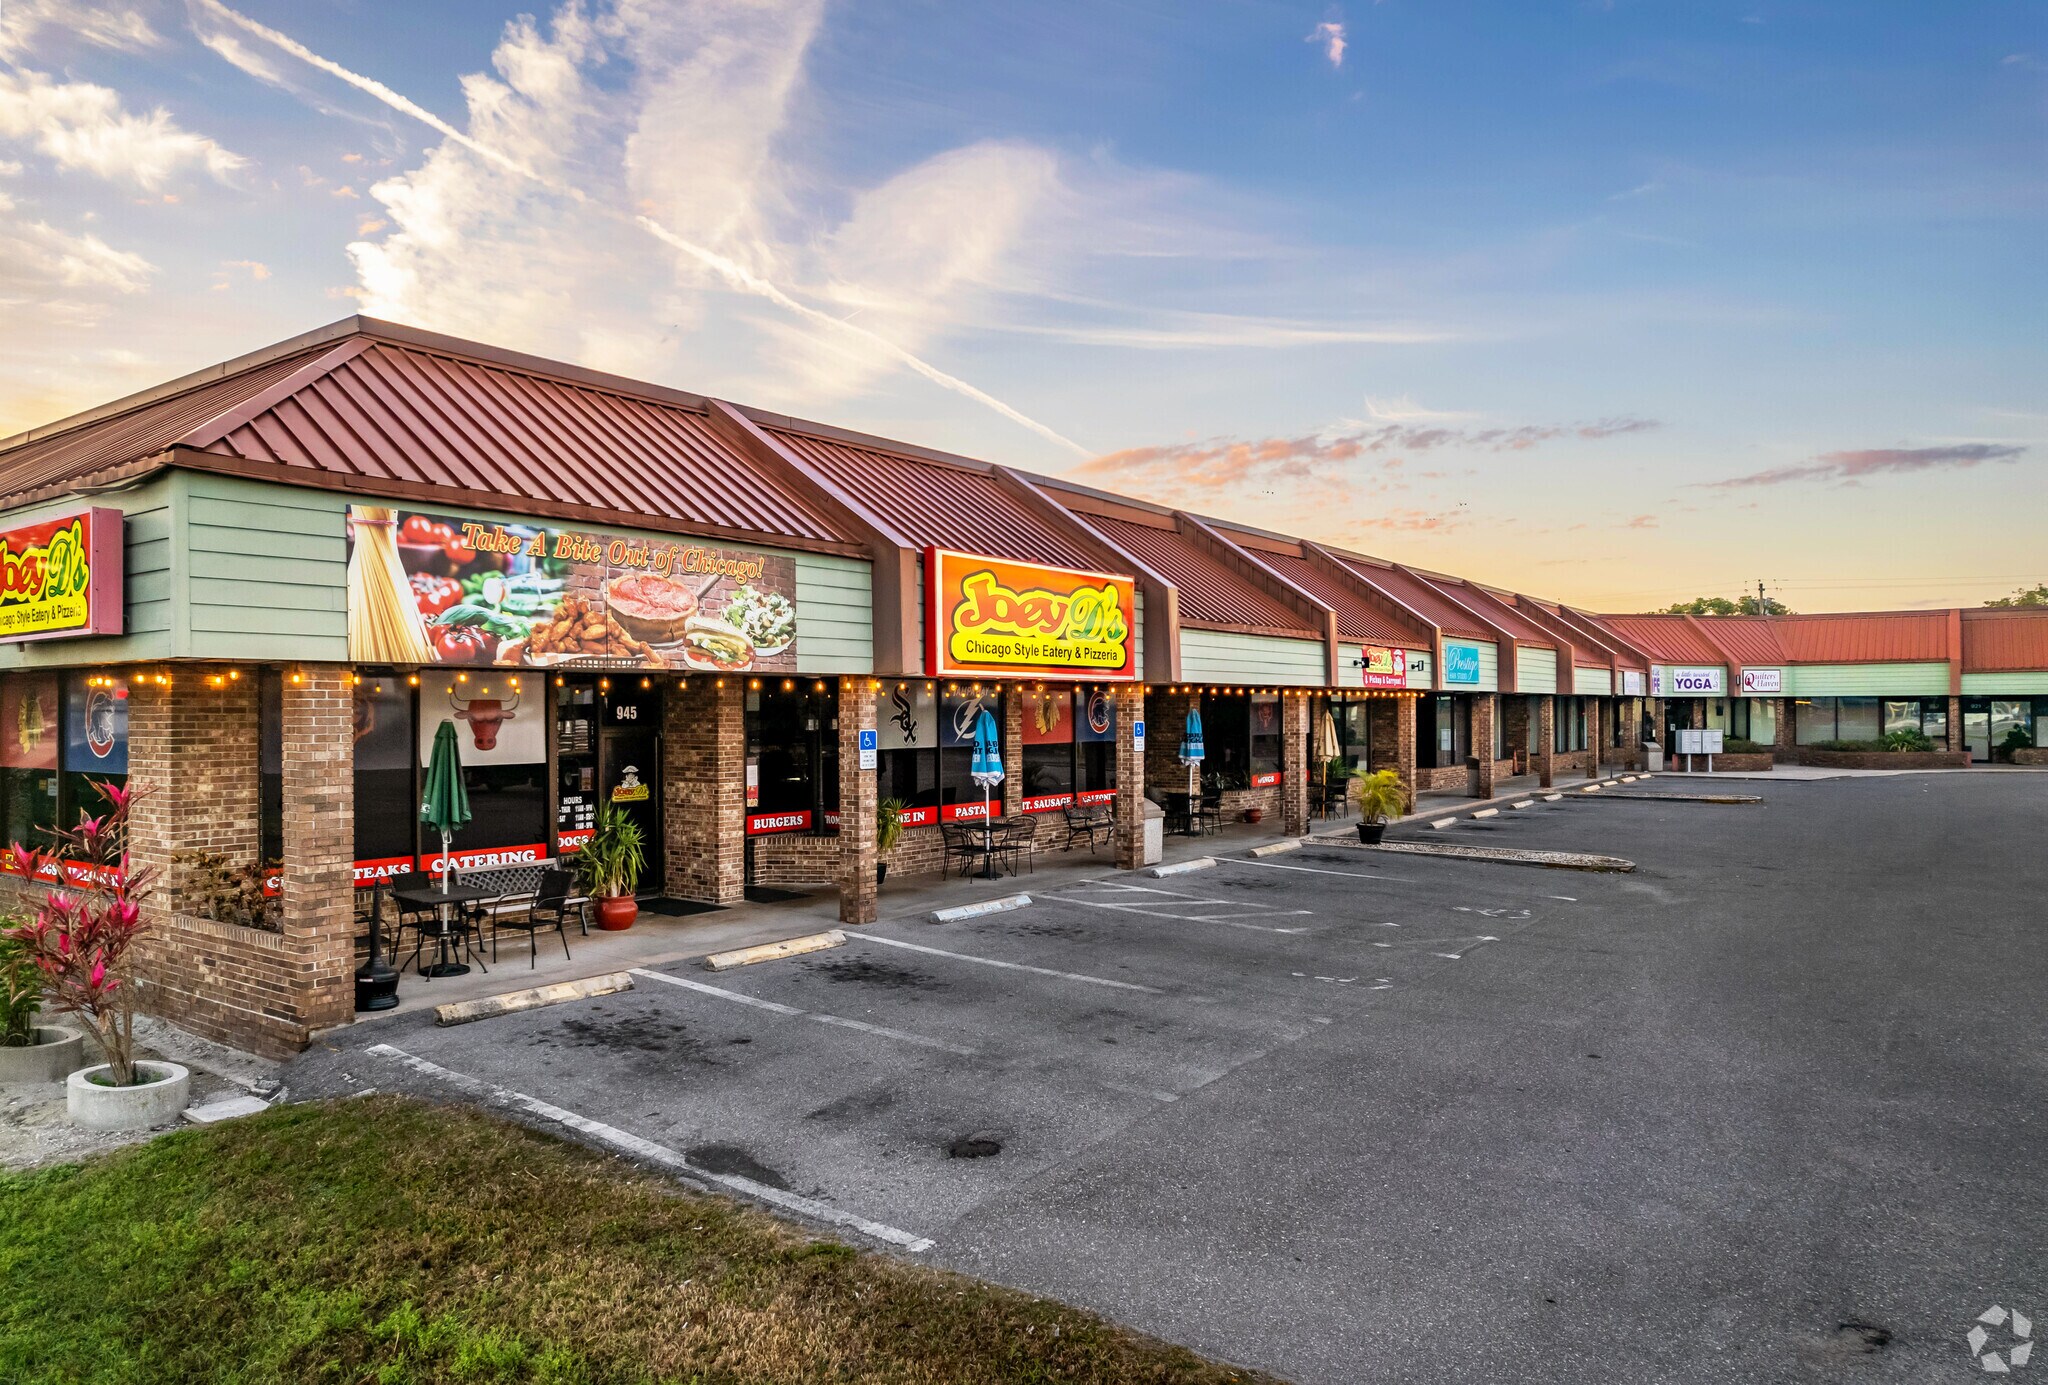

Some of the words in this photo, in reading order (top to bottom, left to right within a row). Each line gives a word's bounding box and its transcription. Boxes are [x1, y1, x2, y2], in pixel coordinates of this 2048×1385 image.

[461, 522, 521, 554] Take
[527, 531, 547, 557] A
[554, 533, 602, 563] Bite
[608, 540, 649, 568] Out
[654, 545, 681, 577] of
[681, 548, 765, 585] Chicago!
[48, 528, 87, 598] D's
[17, 610, 31, 627] Style
[32, 608, 51, 625] Eatery
[52, 606, 56, 620] &
[58, 602, 82, 619] Pizzeria
[960, 579, 1068, 634] Joey
[1070, 592, 1124, 640] D's
[966, 639, 1011, 658] Chicago
[1014, 642, 1039, 660] Style
[1042, 644, 1073, 661] Eatery
[1075, 646, 1081, 658] &
[1083, 647, 1118, 660] Pizzeria
[1449, 647, 1479, 680] Prestige
[1369, 675, 1382, 685] Pickup
[1675, 678, 1712, 689] YOGA
[1745, 672, 1776, 690] Quilters
[1757, 679, 1779, 687] Haven
[616, 705, 638, 720] 945
[563, 796, 583, 805] HOURS
[1034, 796, 1072, 809] SAUSAGE
[913, 811, 925, 822] IN
[955, 805, 987, 817] PASTA
[753, 815, 803, 830] BURGERS
[431, 849, 536, 873] CATERING
[353, 863, 411, 881] TEAKS
